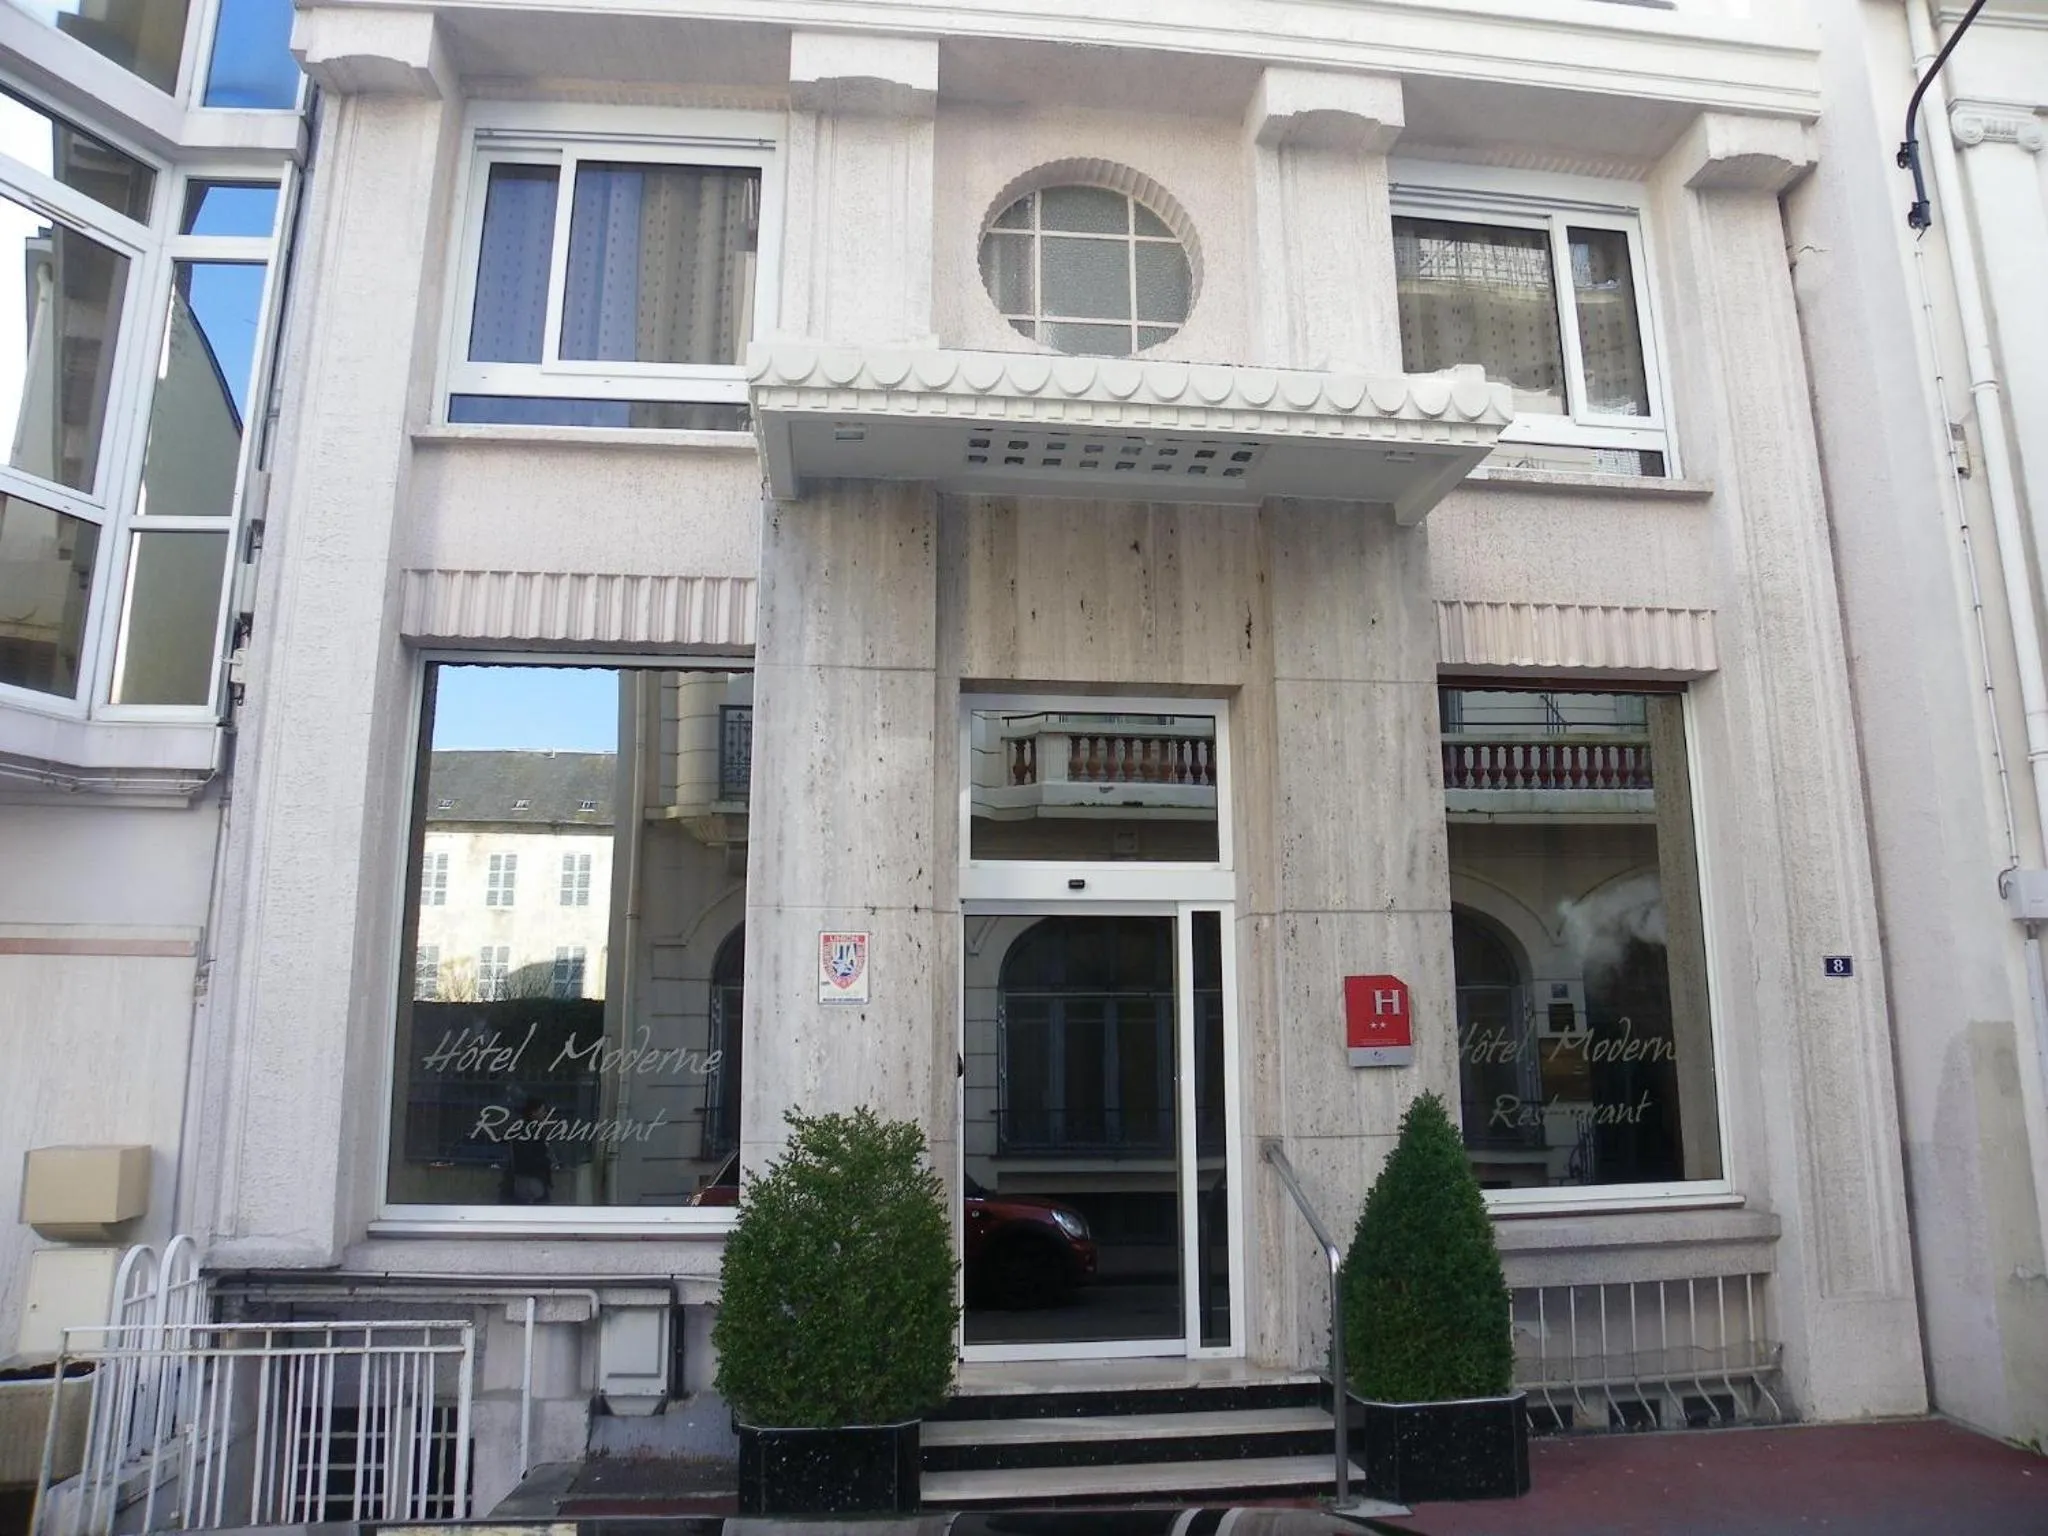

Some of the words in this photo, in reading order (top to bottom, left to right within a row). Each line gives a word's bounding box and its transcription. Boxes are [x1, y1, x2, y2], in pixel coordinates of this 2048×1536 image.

[1833, 959, 1844, 973] 8
[1374, 989, 1401, 1015] H
[421, 1022, 537, 1073] Hôtel
[548, 1024, 723, 1075] Moderne
[1549, 1017, 1678, 1062] Modern
[470, 1105, 669, 1143] Restaurant
[1489, 1090, 1652, 1129] Restrant
